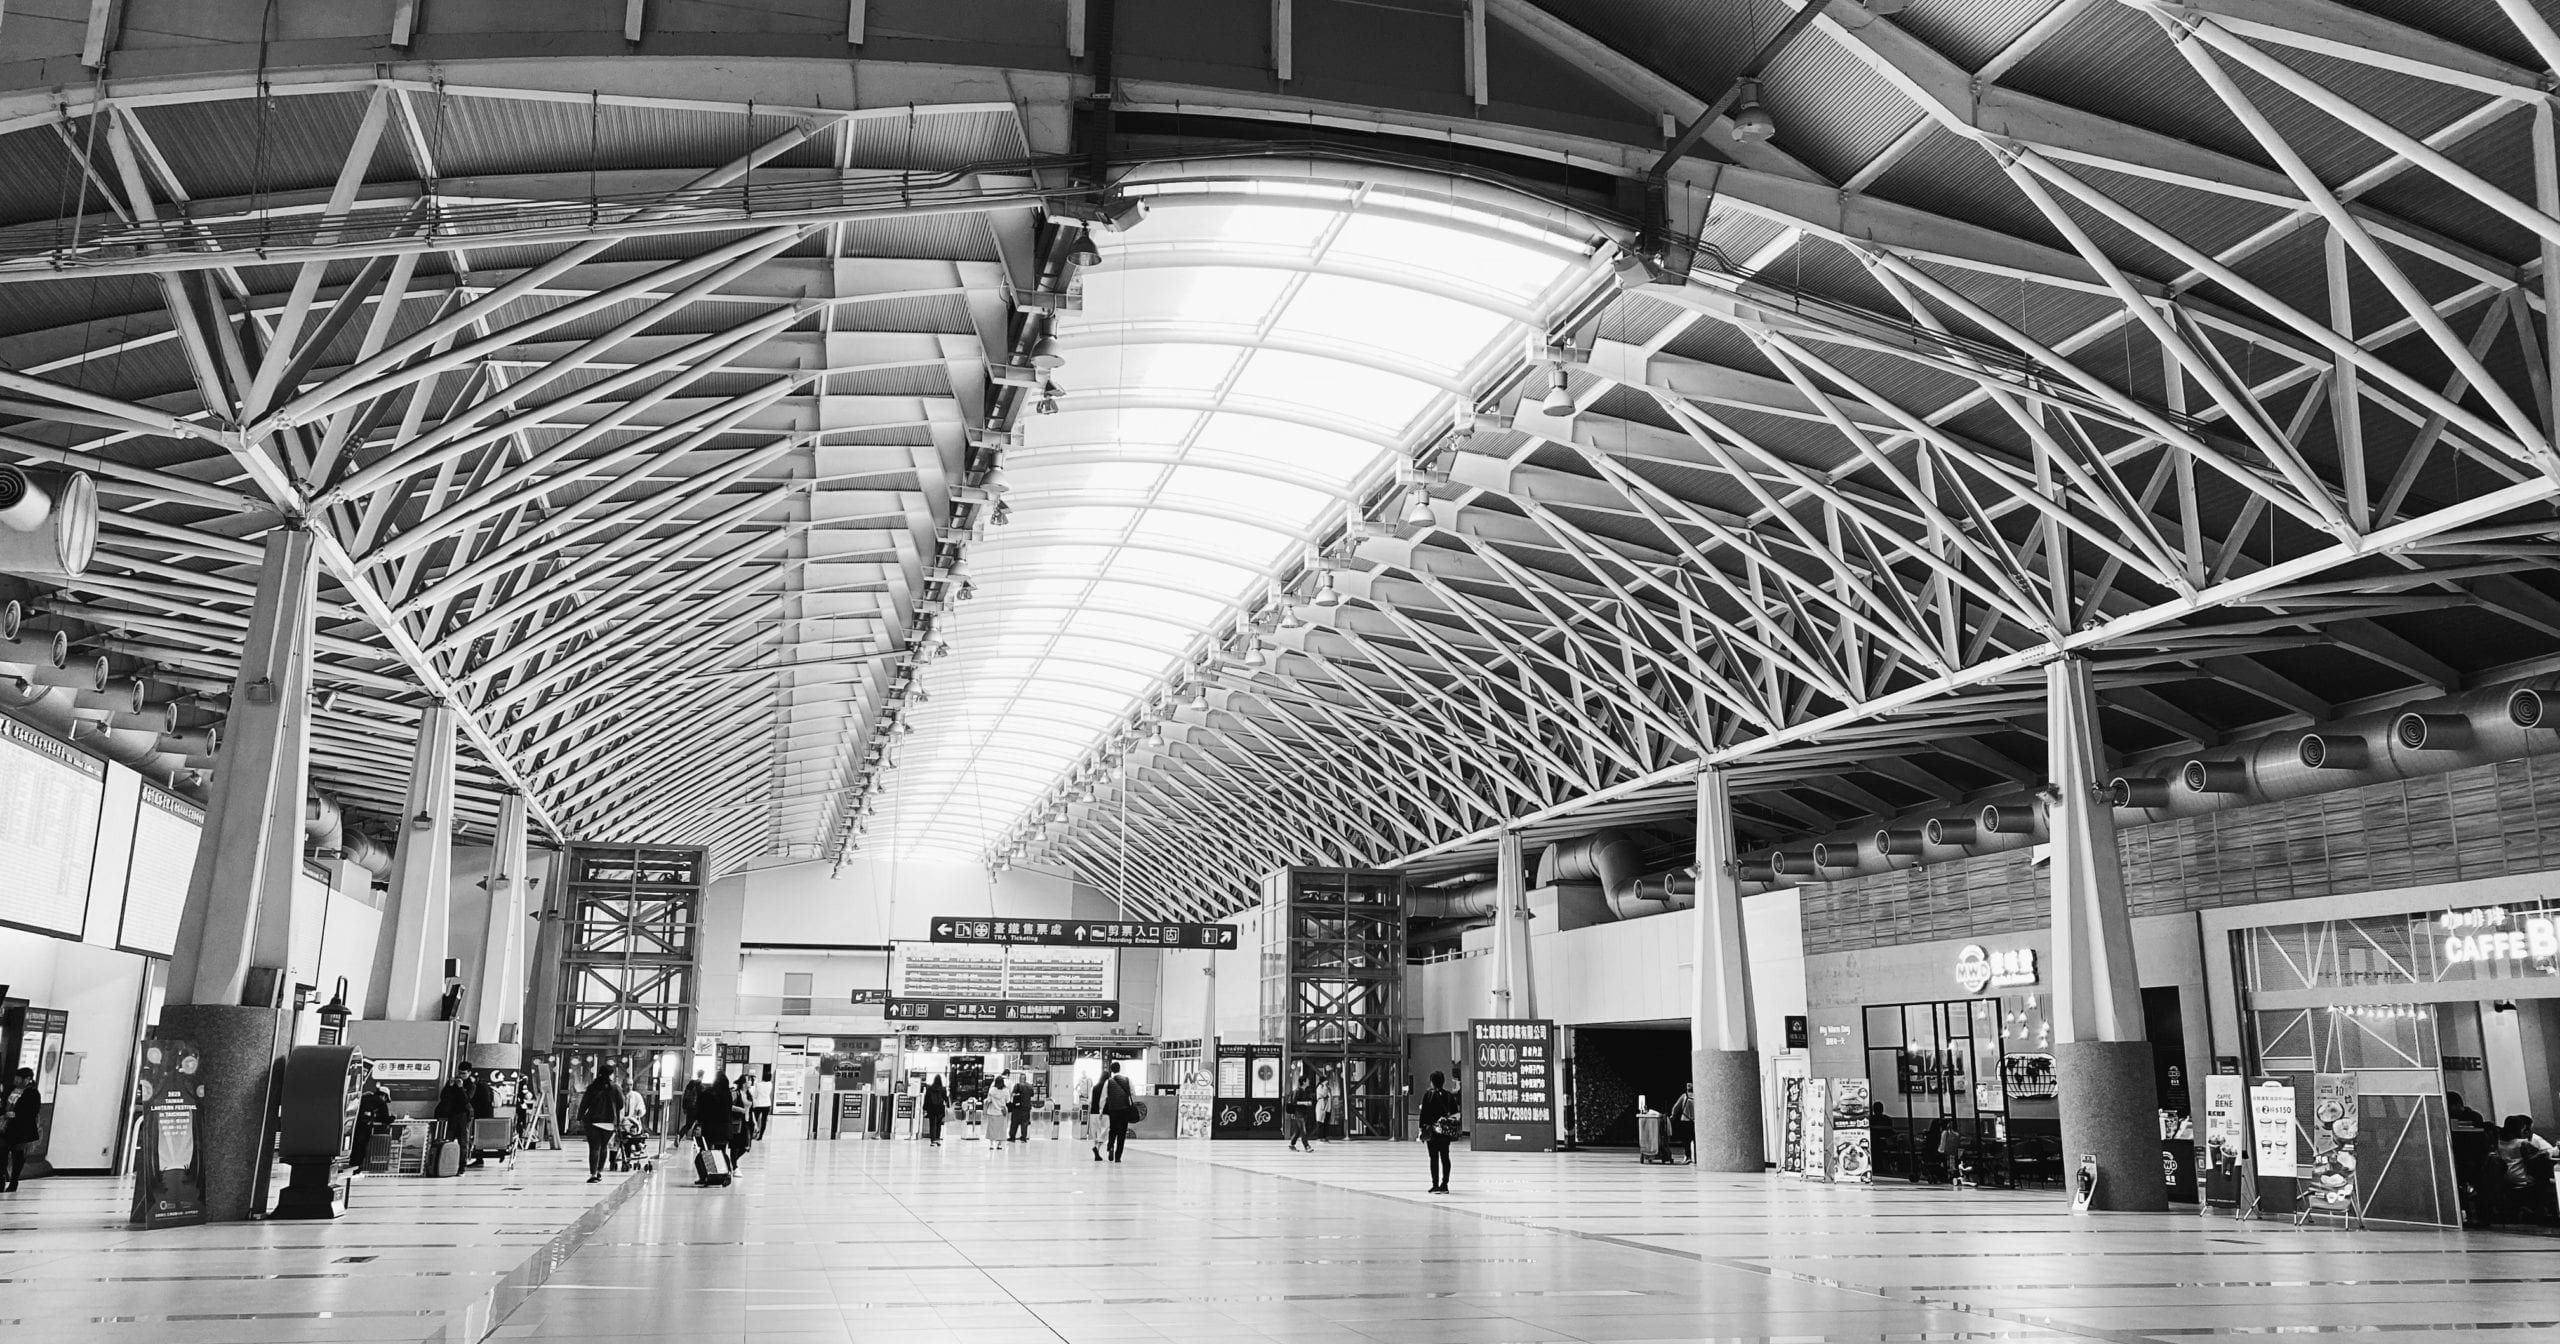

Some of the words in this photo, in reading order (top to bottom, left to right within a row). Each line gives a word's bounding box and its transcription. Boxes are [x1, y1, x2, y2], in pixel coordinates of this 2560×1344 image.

[1108, 925, 1160, 937] 剪票入口
[1010, 935, 1039, 943] Ticketing
[2445, 931, 2528, 963] CAFFE
[1956, 962, 1990, 982] MWD
[2215, 1100, 2233, 1108] BENE
